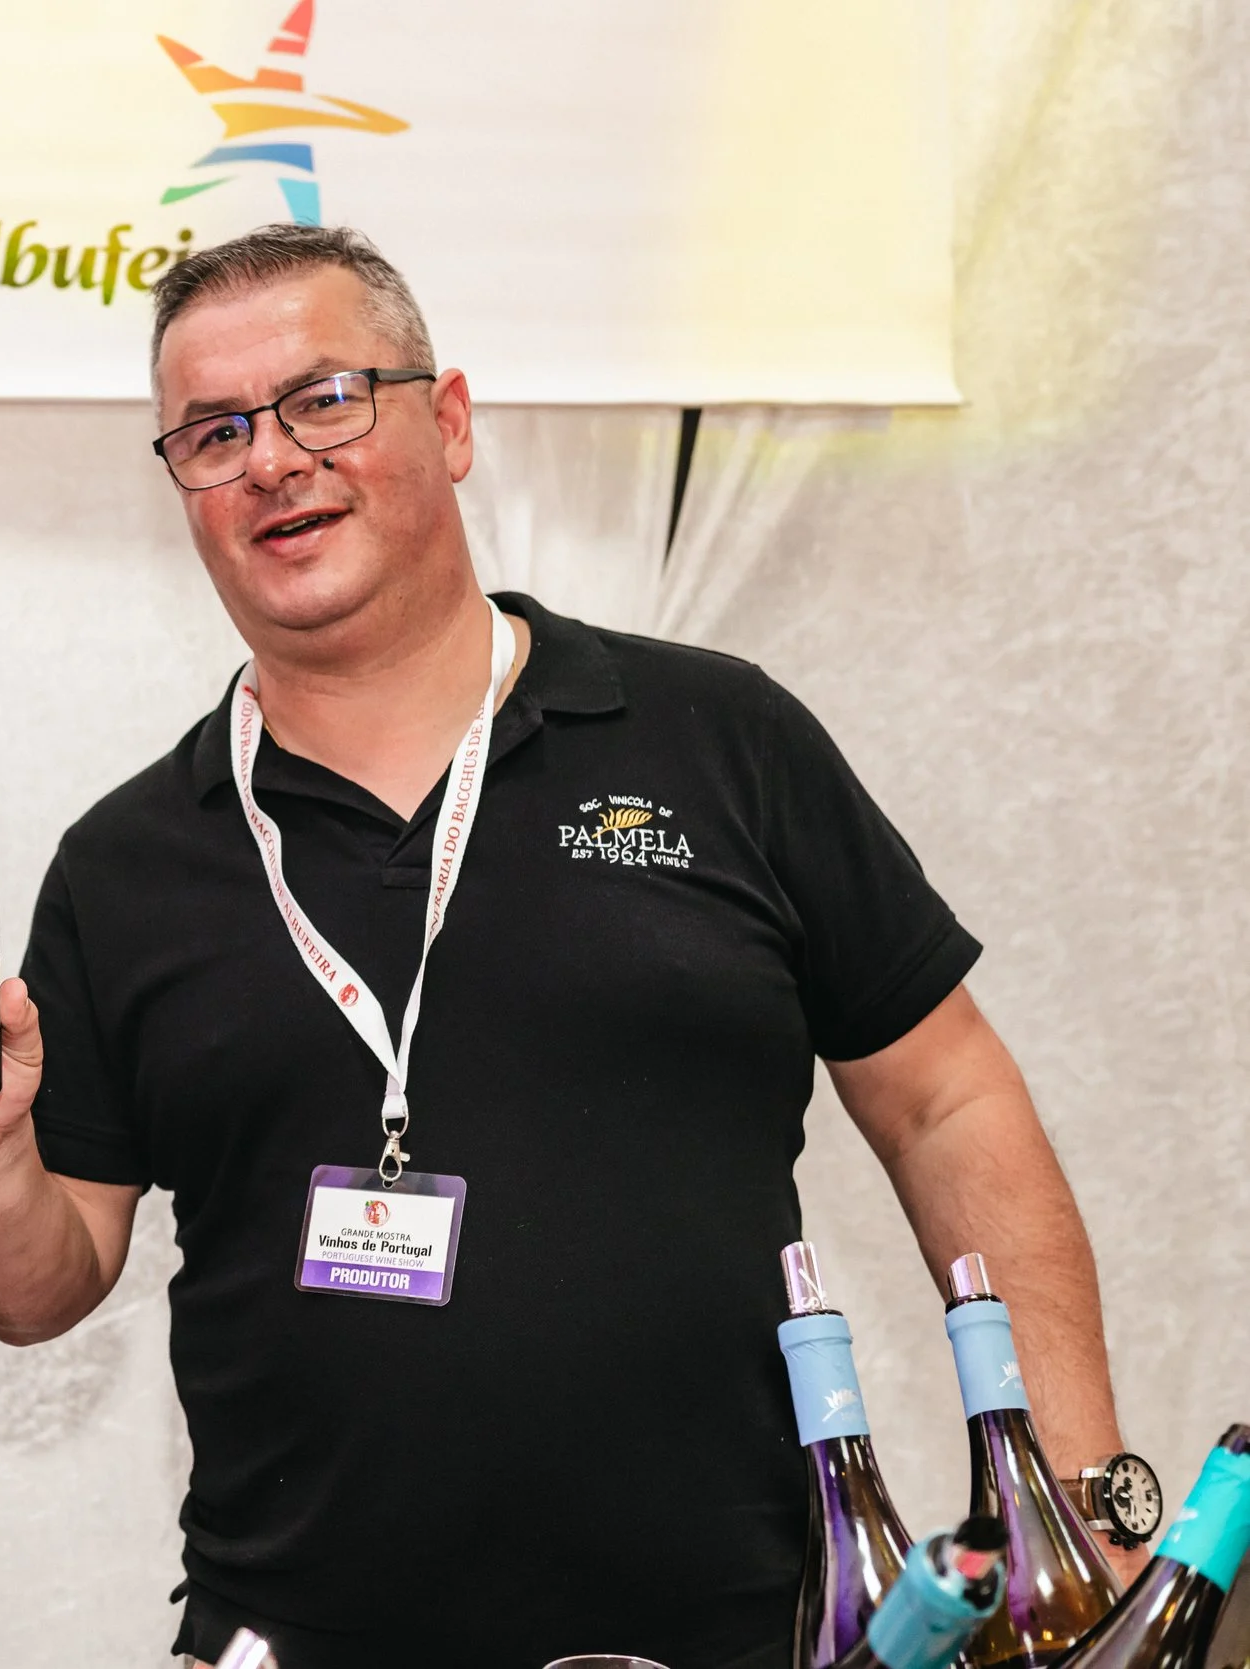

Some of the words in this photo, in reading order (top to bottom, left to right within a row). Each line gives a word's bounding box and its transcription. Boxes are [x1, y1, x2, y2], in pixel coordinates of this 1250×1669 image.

[468, 724, 484, 746] DE
[451, 749, 479, 823] BACCHUS
[608, 795, 652, 809] VINICOLA
[658, 806, 673, 818] DE
[239, 702, 255, 783] CONFRARIA
[284, 903, 337, 982] ALBUFEIRA
[444, 826, 461, 853] DO
[558, 825, 694, 858] PALMELA
[600, 844, 648, 867] 1964
[429, 857, 454, 934] NFRARIA
[319, 1235, 358, 1250] Vinhos
[362, 1239, 376, 1252] de
[380, 1241, 433, 1258] Portugal
[341, 1228, 375, 1239] GRANDE
[376, 1231, 411, 1242] MOSTRA
[322, 1250, 374, 1264] PORTUGUESE
[375, 1256, 398, 1266] WINE
[398, 1258, 425, 1268] SHOW
[330, 1267, 410, 1289] PRODUTOR
